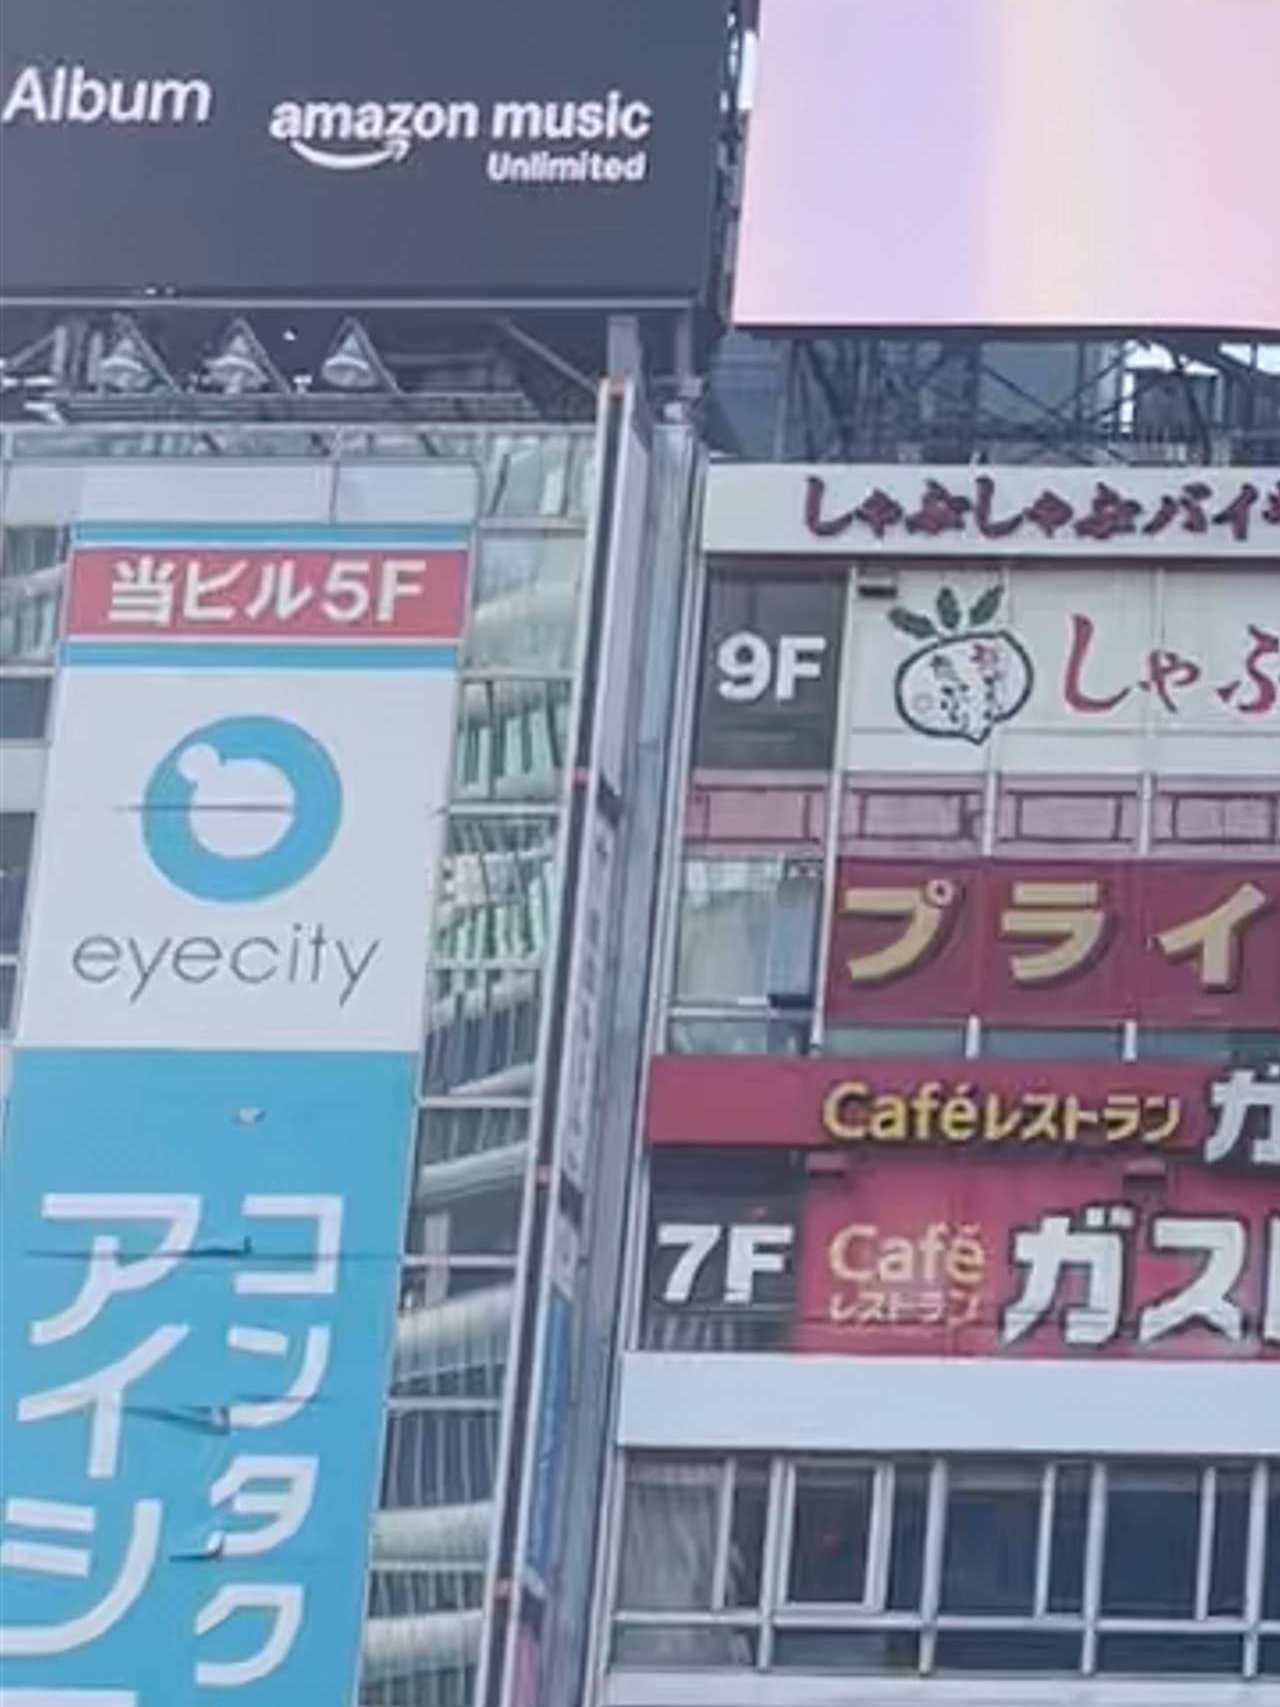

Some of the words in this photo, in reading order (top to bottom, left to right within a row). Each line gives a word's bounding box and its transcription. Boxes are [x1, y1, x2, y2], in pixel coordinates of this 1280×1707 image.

[2, 66, 213, 123] Album
[268, 99, 478, 140] amazon
[490, 91, 652, 139] music
[487, 150, 646, 182] Unlimited
[108, 556, 427, 625] 当ビル5F
[716, 633, 828, 701] 9F
[72, 922, 380, 1006] eyecity
[656, 1224, 794, 1304] 7F
